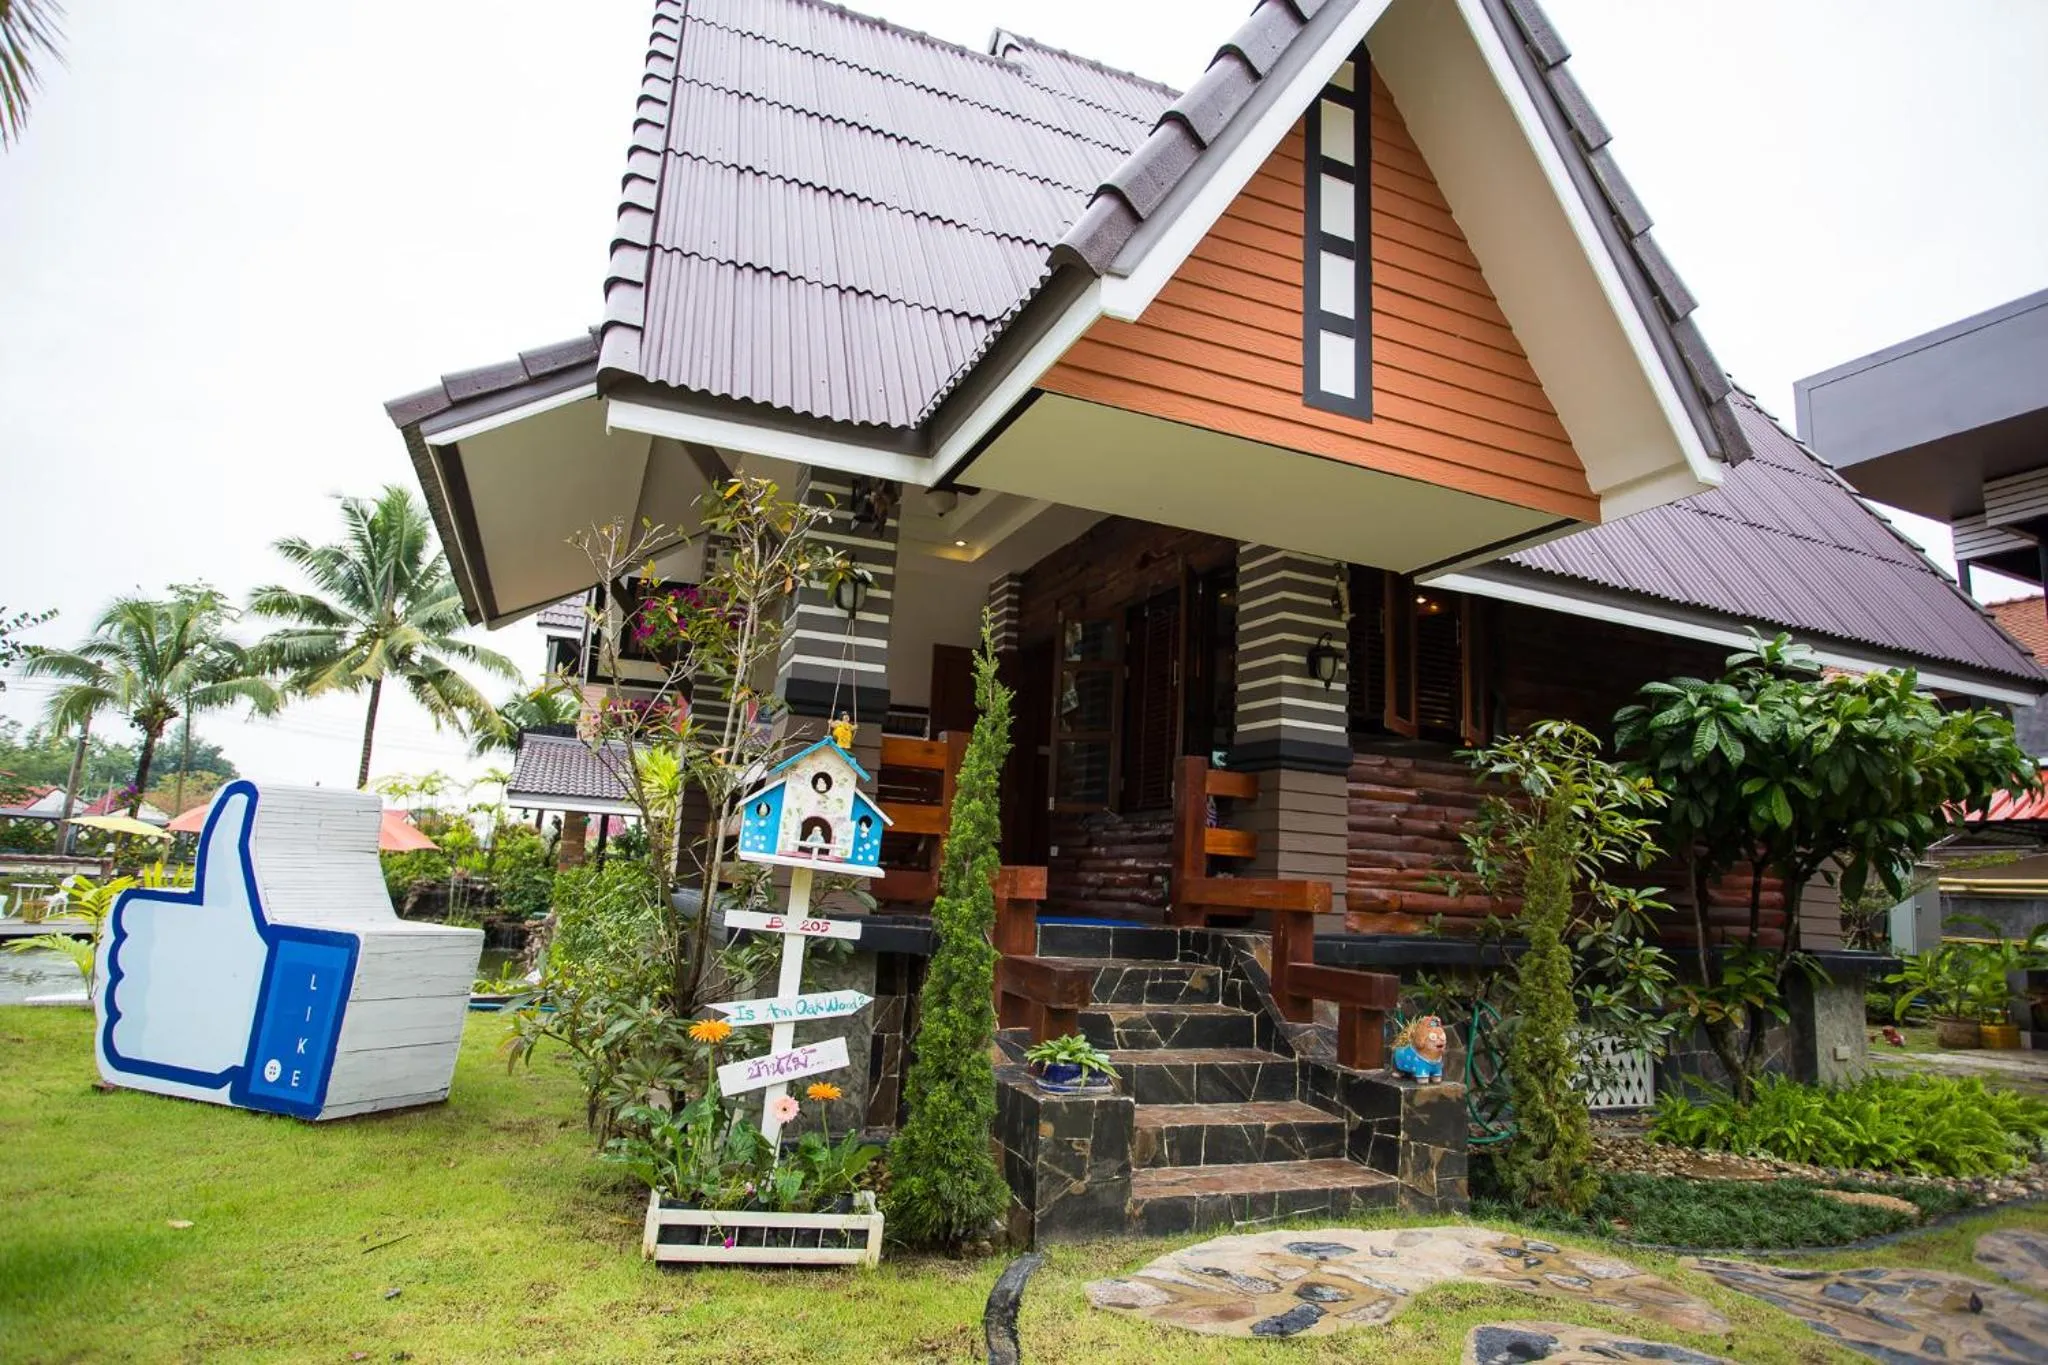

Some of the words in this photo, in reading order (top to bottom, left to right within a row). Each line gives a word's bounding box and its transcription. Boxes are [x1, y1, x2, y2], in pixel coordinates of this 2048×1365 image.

[799, 919, 831, 933] 205
[735, 1004, 755, 1021] Is
[291, 973, 317, 1087] LIKE
